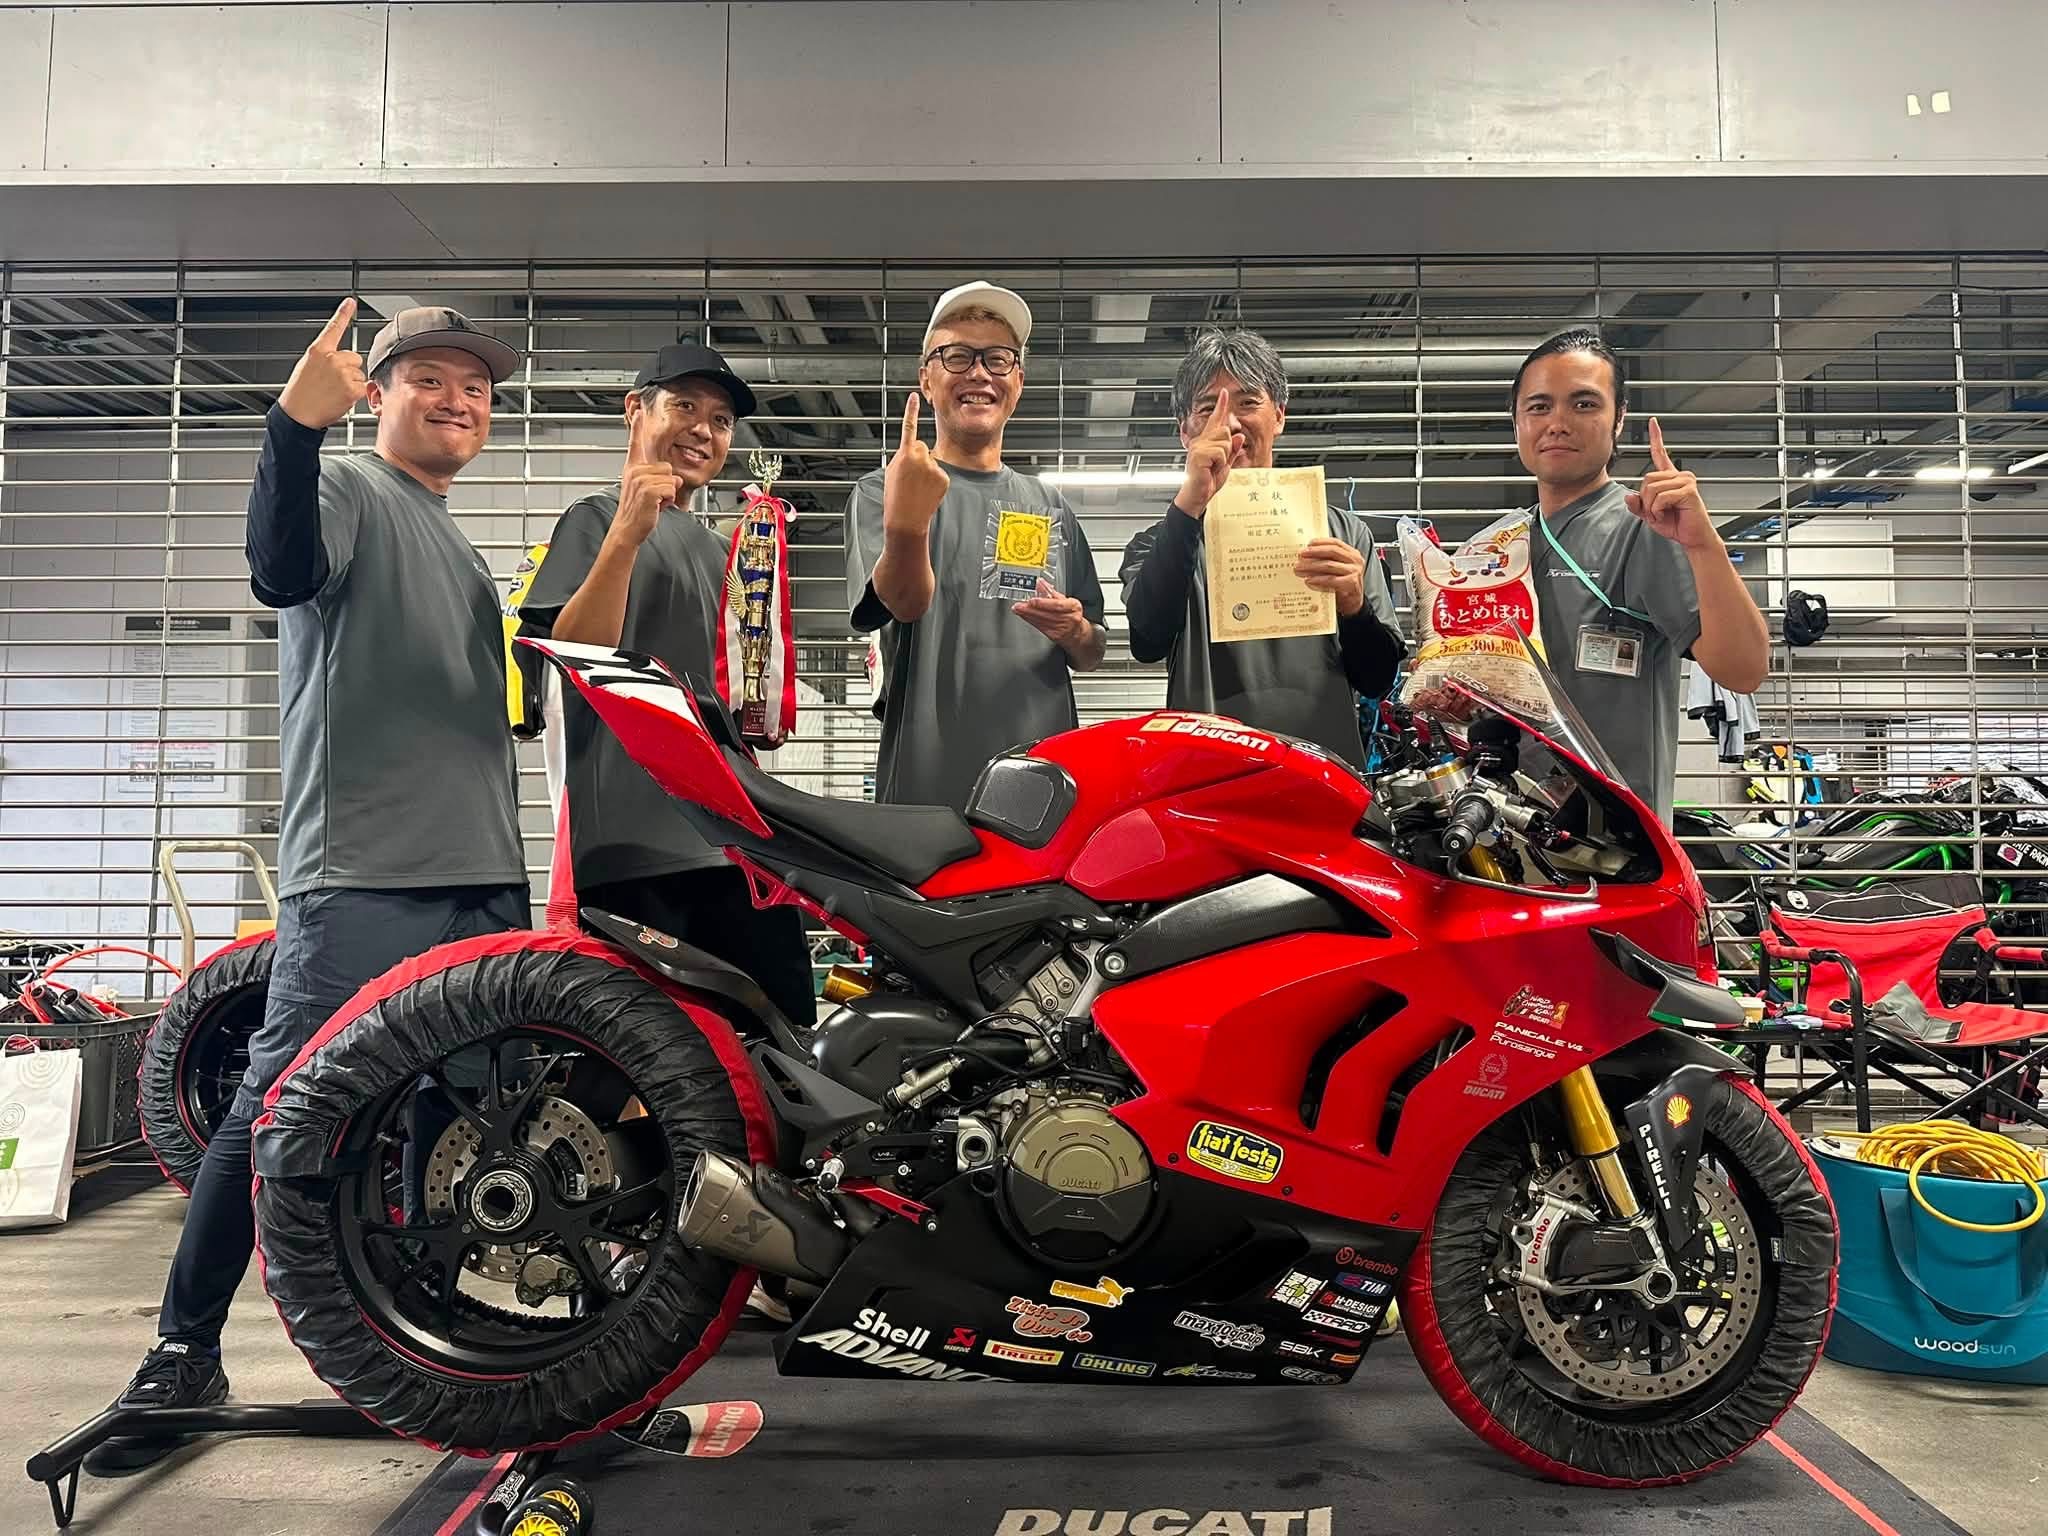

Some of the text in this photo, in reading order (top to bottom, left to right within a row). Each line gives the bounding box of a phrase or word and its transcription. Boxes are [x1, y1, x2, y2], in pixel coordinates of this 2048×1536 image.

[1191, 726, 1271, 752] DUCATI
[1489, 1034, 1557, 1060] Purosangue
[1463, 1085, 1506, 1100] DUCATI
[1196, 1124, 1231, 1154] fiat
[1229, 1135, 1279, 1169] festa
[1638, 1123, 1673, 1211] PIRELLI
[1059, 1176, 1102, 1190] DUCATI
[1527, 1217, 1551, 1266] brembo
[1353, 1255, 1399, 1276] brembo
[1360, 1279, 1387, 1295] TIM
[853, 1307, 931, 1351] Shell
[991, 1343, 1057, 1363] PIRELLI
[1279, 1340, 1326, 1359] SBK
[1913, 1335, 2017, 1356] woodsun
[1079, 1353, 1151, 1376] ÖHLINS
[702, 1405, 747, 1453] DUCATI
[994, 1506, 1333, 1536] DUCATI
